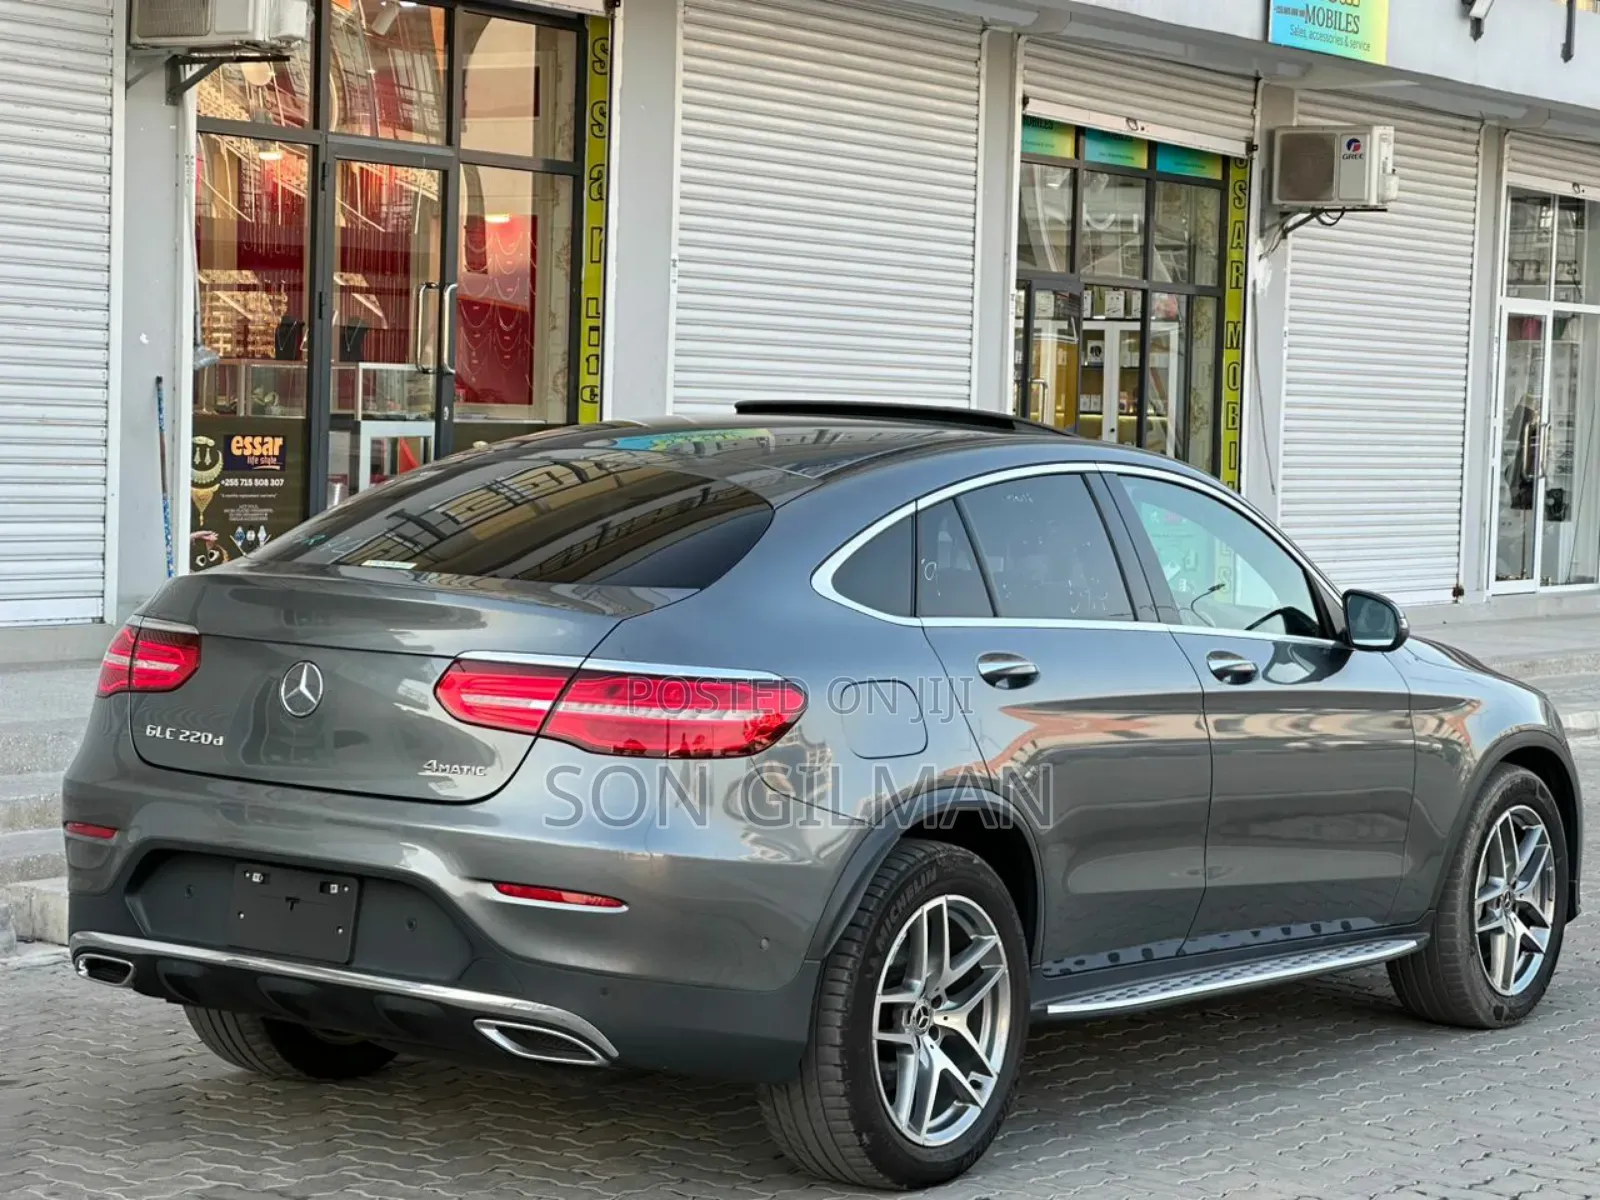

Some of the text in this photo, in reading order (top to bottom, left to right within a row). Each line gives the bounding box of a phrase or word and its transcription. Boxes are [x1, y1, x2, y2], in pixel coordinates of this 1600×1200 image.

[1305, 4, 1360, 34] MOBILES
[230, 435, 284, 456] essar
[247, 456, 258, 465] life
[220, 478, 239, 487] +255
[239, 478, 253, 487] 715
[145, 724, 224, 746] GLC 220d
[422, 759, 487, 776] 4MATIC
